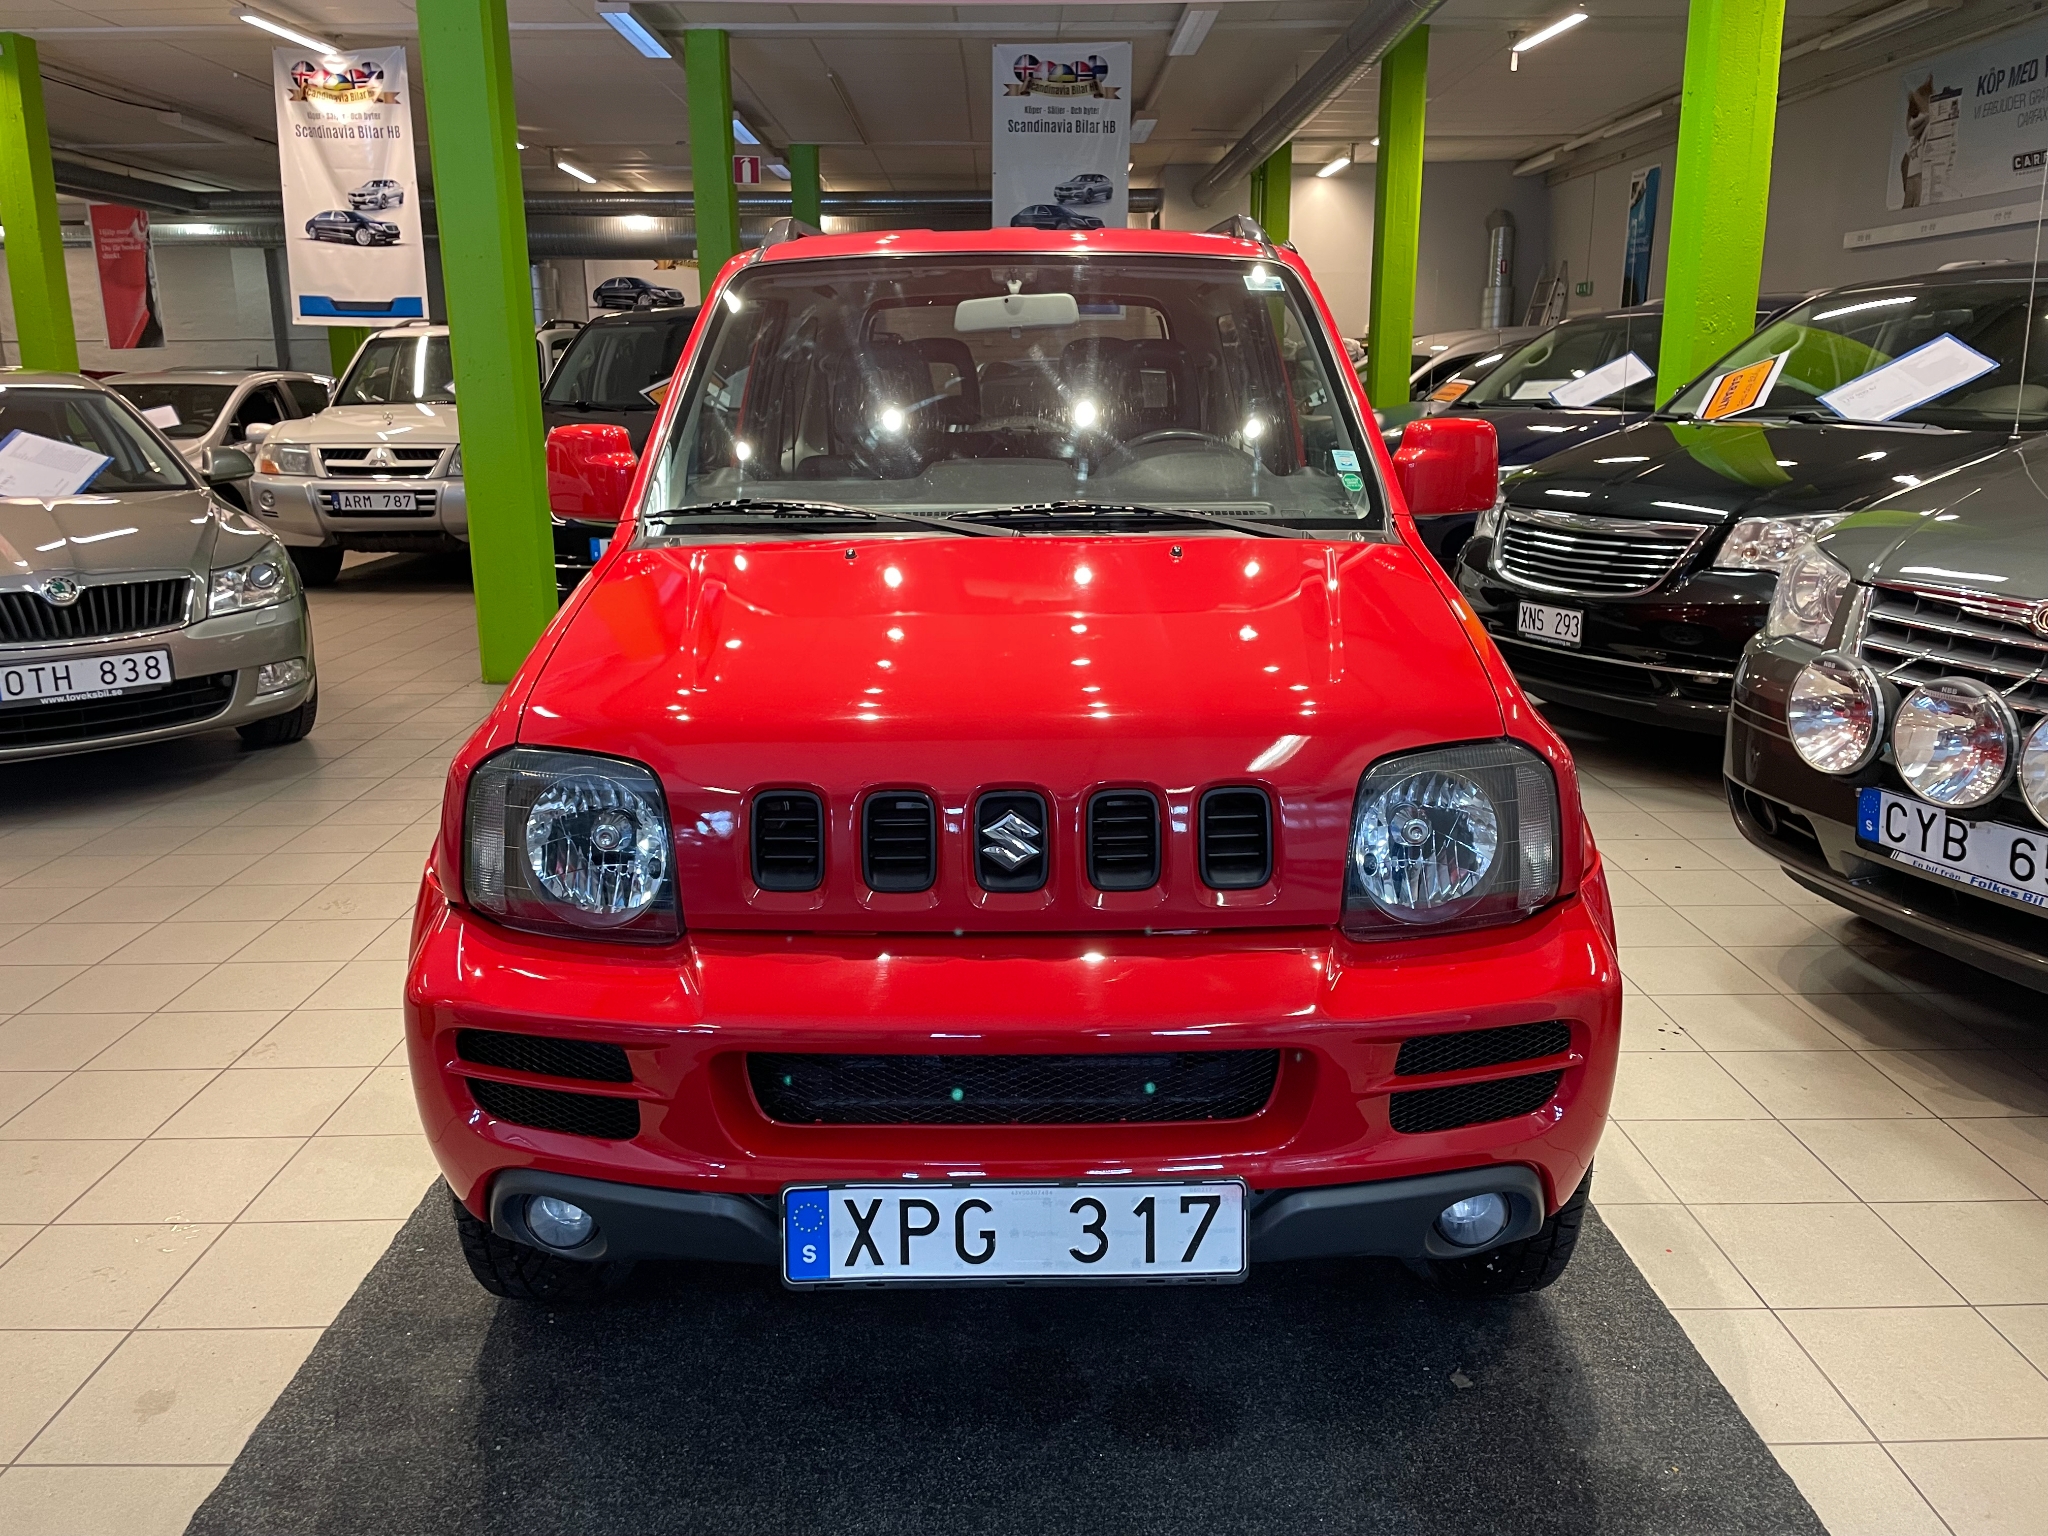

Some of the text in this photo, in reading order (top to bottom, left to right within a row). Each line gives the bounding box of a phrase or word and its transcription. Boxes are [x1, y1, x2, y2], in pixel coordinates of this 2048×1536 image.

[1975, 66, 2005, 97] KÖP
[2007, 58, 2039, 88] MED
[1024, 105, 1042, 115] Köper
[1070, 106, 1082, 115] Och
[1083, 106, 1100, 116] byter
[295, 123, 401, 139] Scandinavia Bilar HB
[1007, 118, 1116, 134] Scandinavia Bilar HB
[344, 495, 411, 509] ARM 787
[1520, 605, 1580, 638] XNS 293
[1823, 660, 1836, 669] NBB
[4, 655, 162, 697] OTH 838
[40, 688, 124, 706] www.toveksbil.se
[1941, 686, 1958, 695] NBB
[1865, 819, 1873, 831] S
[1885, 801, 2048, 883] CYB 6
[1912, 860, 1961, 881] En bil från
[1969, 876, 2045, 906] Folkes Bil
[843, 1195, 1221, 1265] XPG 317
[802, 1245, 817, 1264] S
